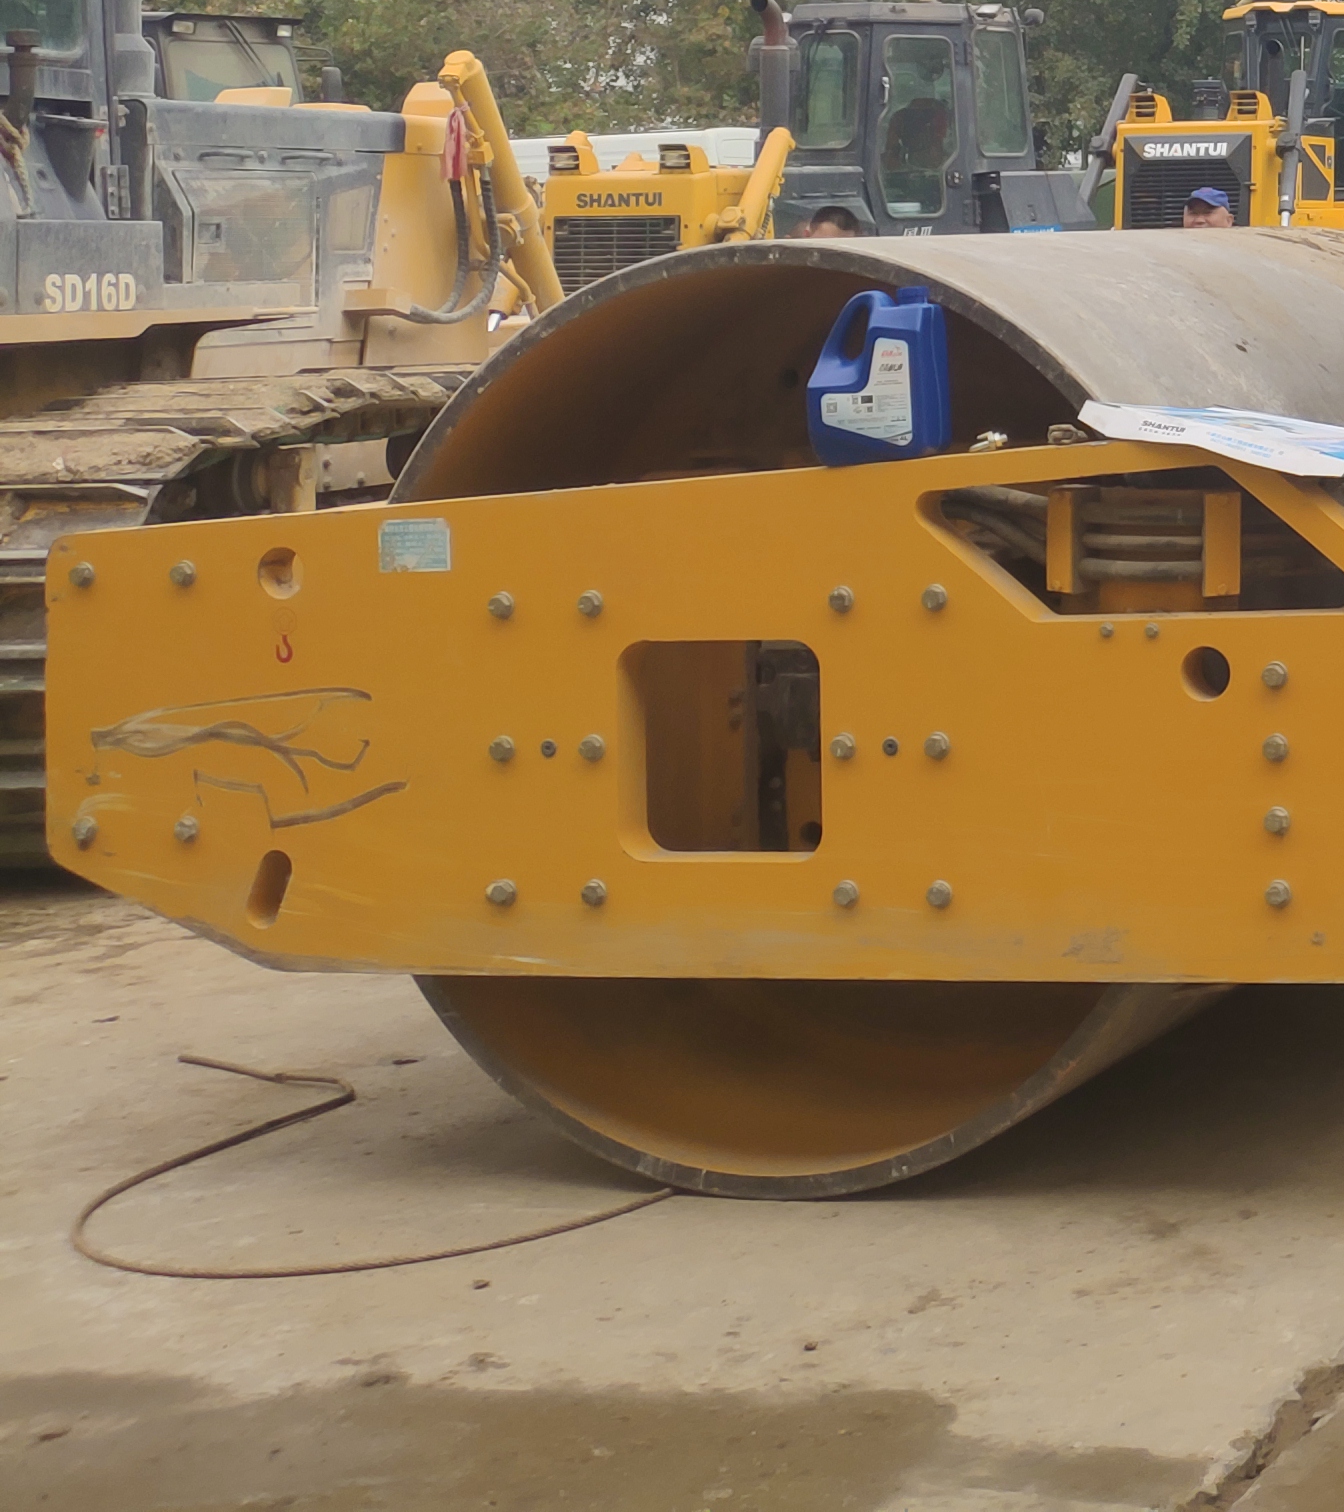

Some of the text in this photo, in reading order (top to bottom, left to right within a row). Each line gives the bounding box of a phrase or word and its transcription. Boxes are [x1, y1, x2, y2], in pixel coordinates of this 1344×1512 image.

[1142, 141, 1229, 159] SHANTUI
[575, 191, 663, 209] SHANTUI
[44, 273, 137, 313] SD16D
[1141, 419, 1187, 434] SHANTUI
